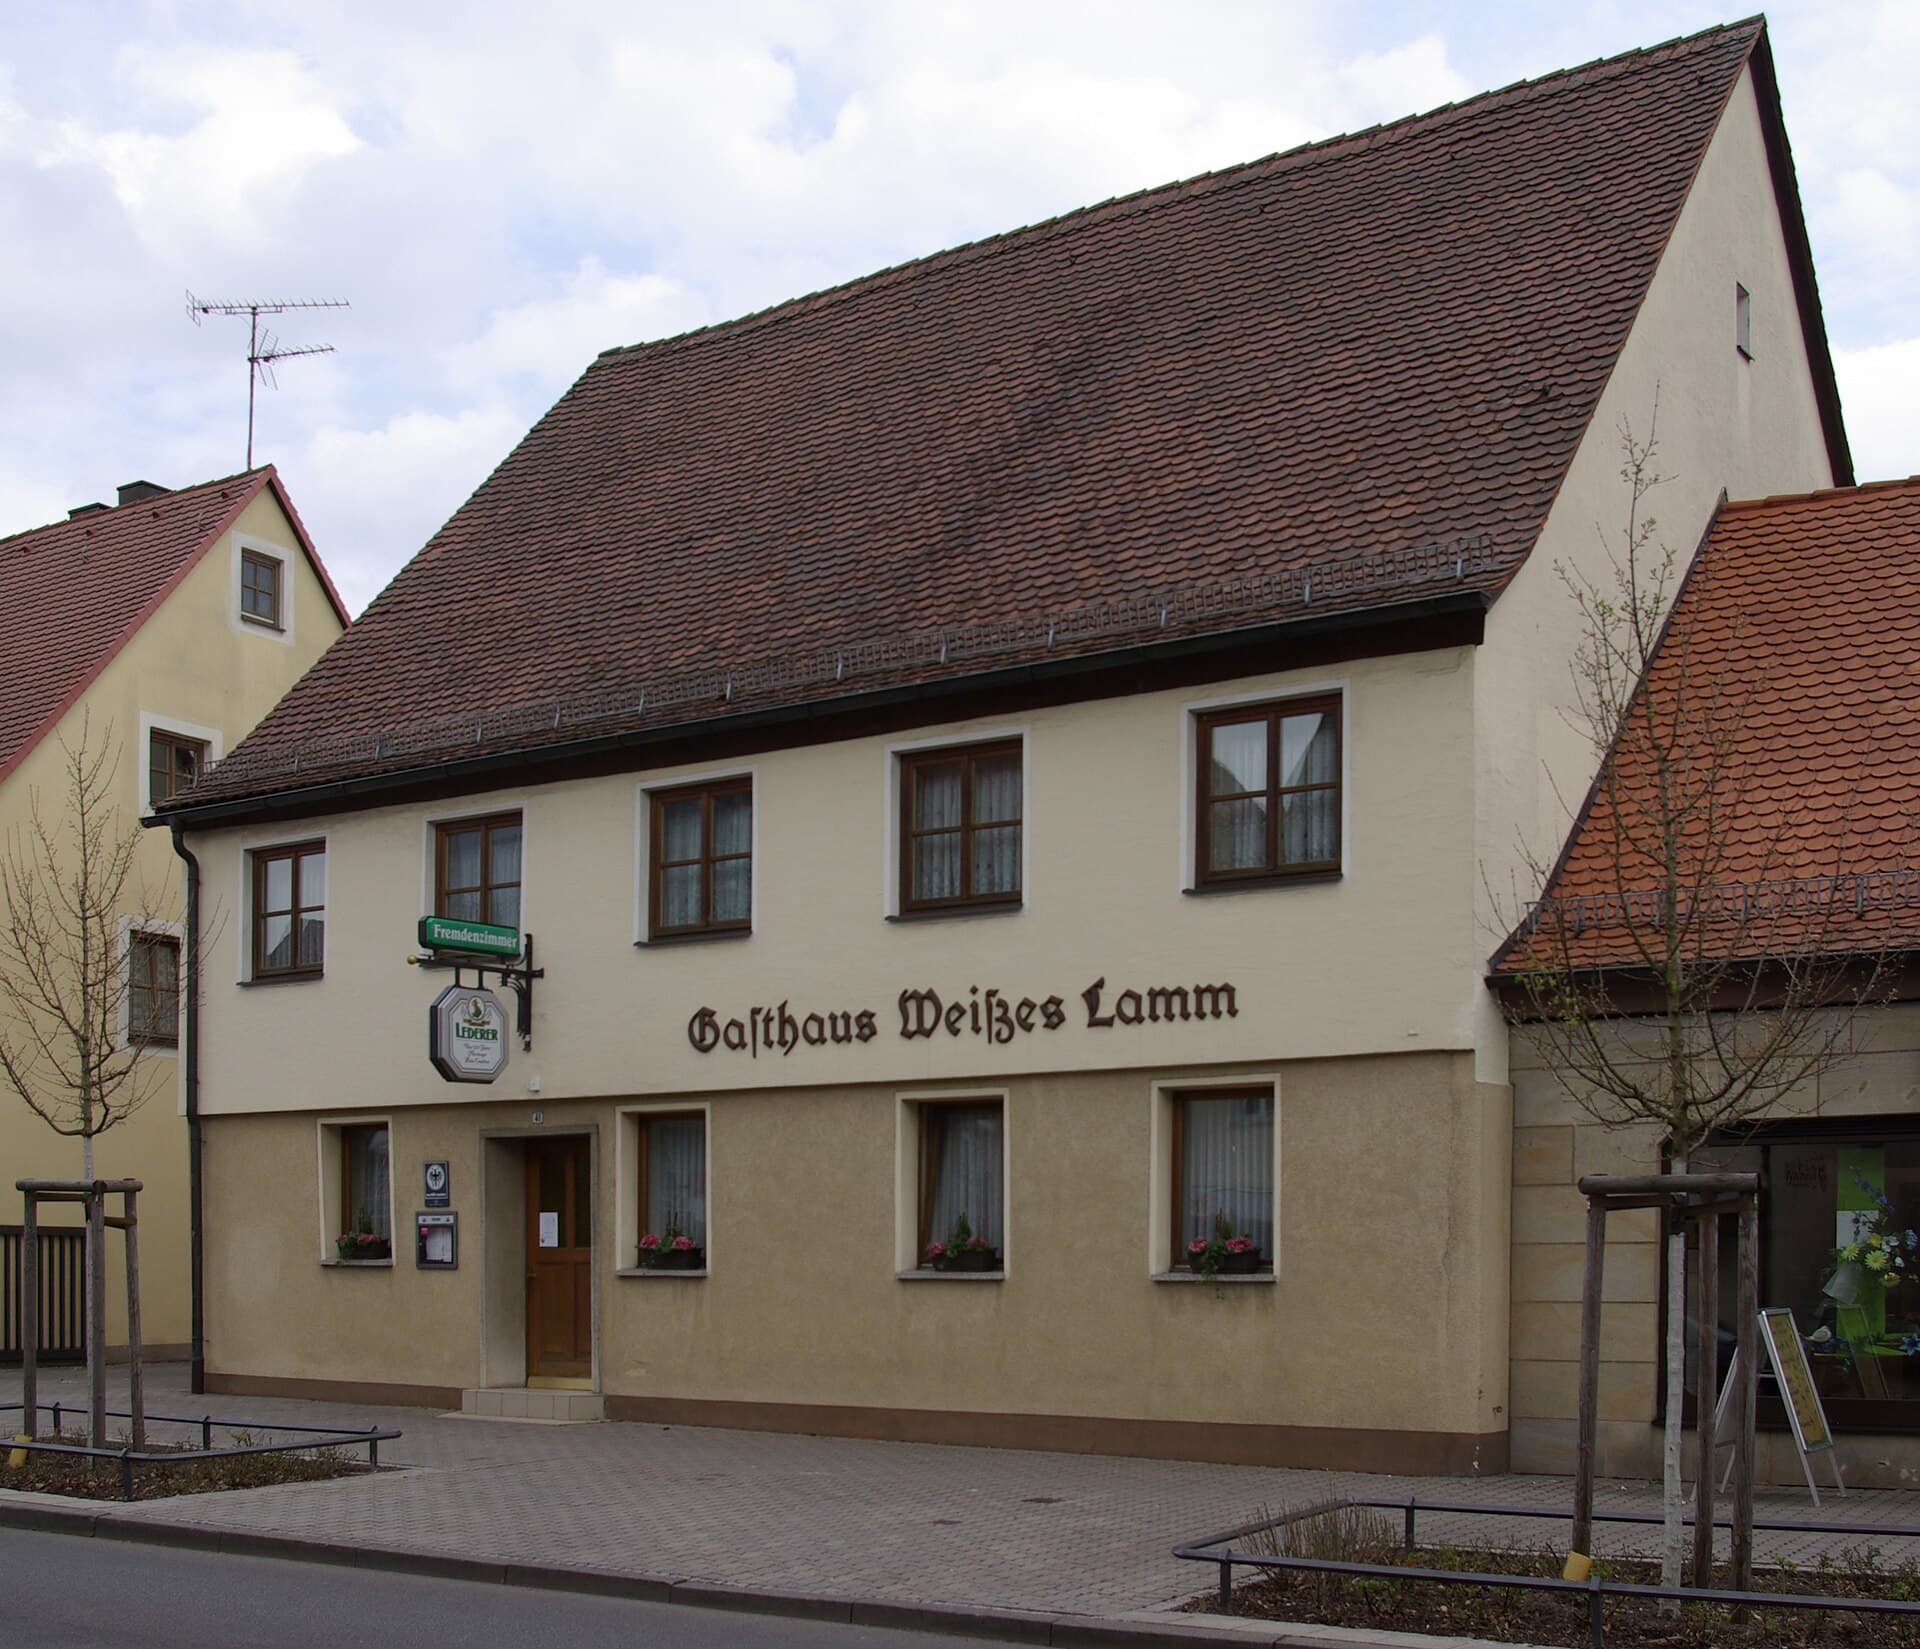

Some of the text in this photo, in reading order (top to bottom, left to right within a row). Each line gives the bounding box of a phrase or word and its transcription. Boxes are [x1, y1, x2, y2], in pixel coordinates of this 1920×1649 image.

[433, 923, 518, 948] Fremdenzimmer
[1081, 977, 1239, 1028] Lamm
[455, 1022, 498, 1041] LEDERER
